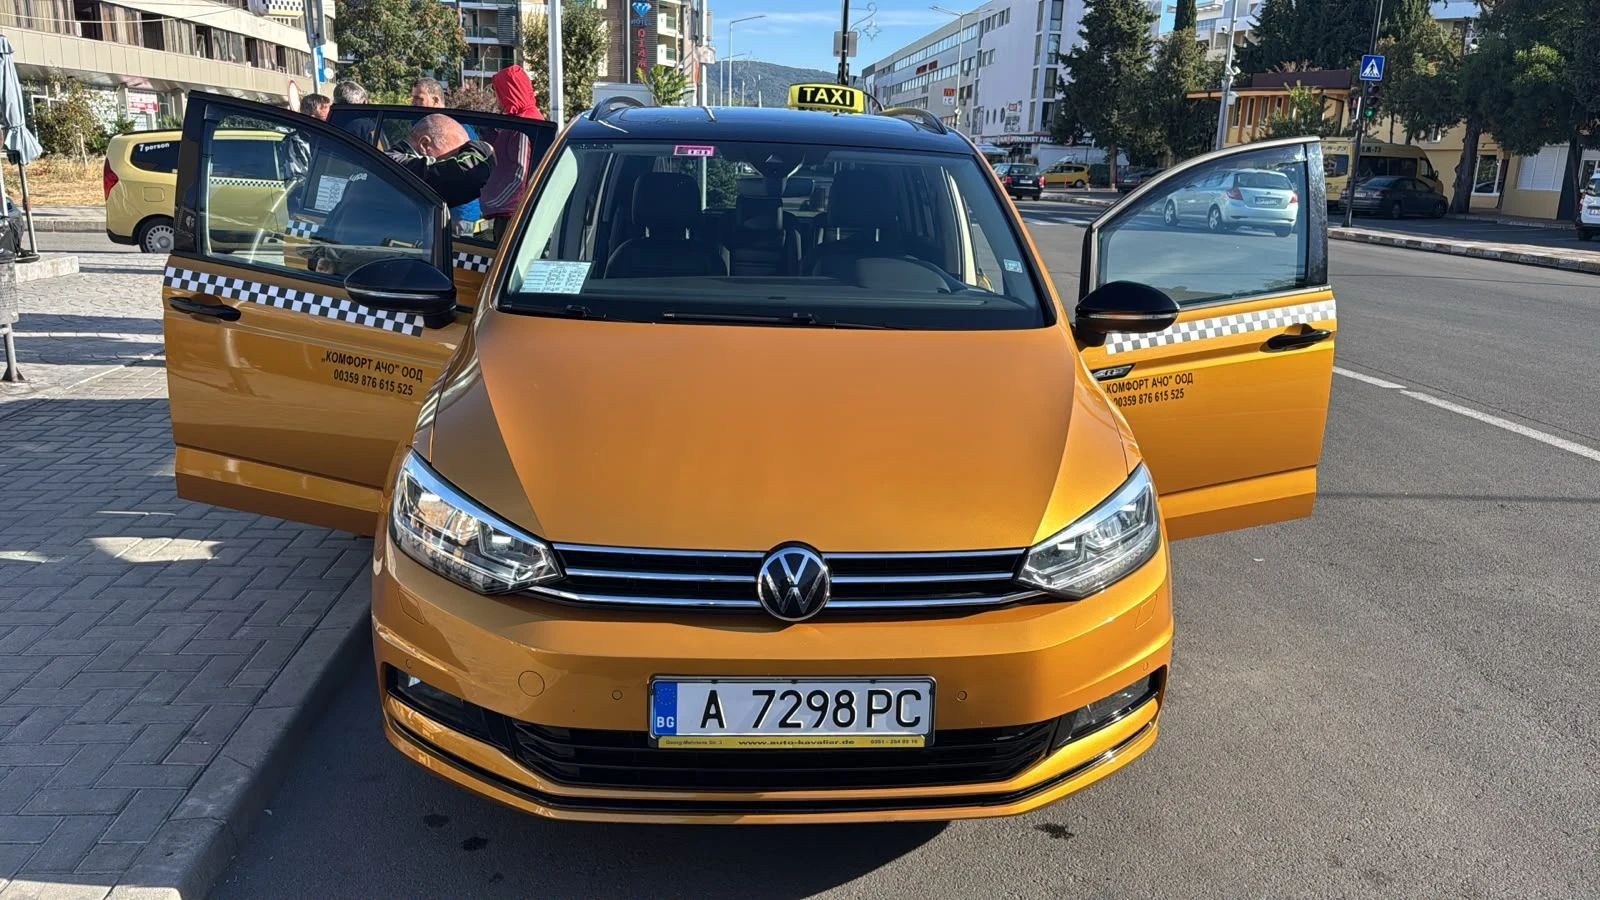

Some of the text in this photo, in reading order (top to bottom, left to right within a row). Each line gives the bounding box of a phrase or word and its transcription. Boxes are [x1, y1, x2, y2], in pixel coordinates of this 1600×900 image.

[802, 87, 852, 106] TAXI
[138, 142, 170, 153] 7 person
[321, 351, 373, 370] „КОМФОРТ
[401, 366, 423, 383] ООД
[333, 369, 413, 396] 00359 876 615 525
[1175, 373, 1194, 385] ООД
[1138, 392, 1153, 405] 876
[1155, 390, 1169, 402] 615
[1170, 388, 1185, 400] 525
[700, 689, 727, 729] A
[656, 716, 675, 728] BG
